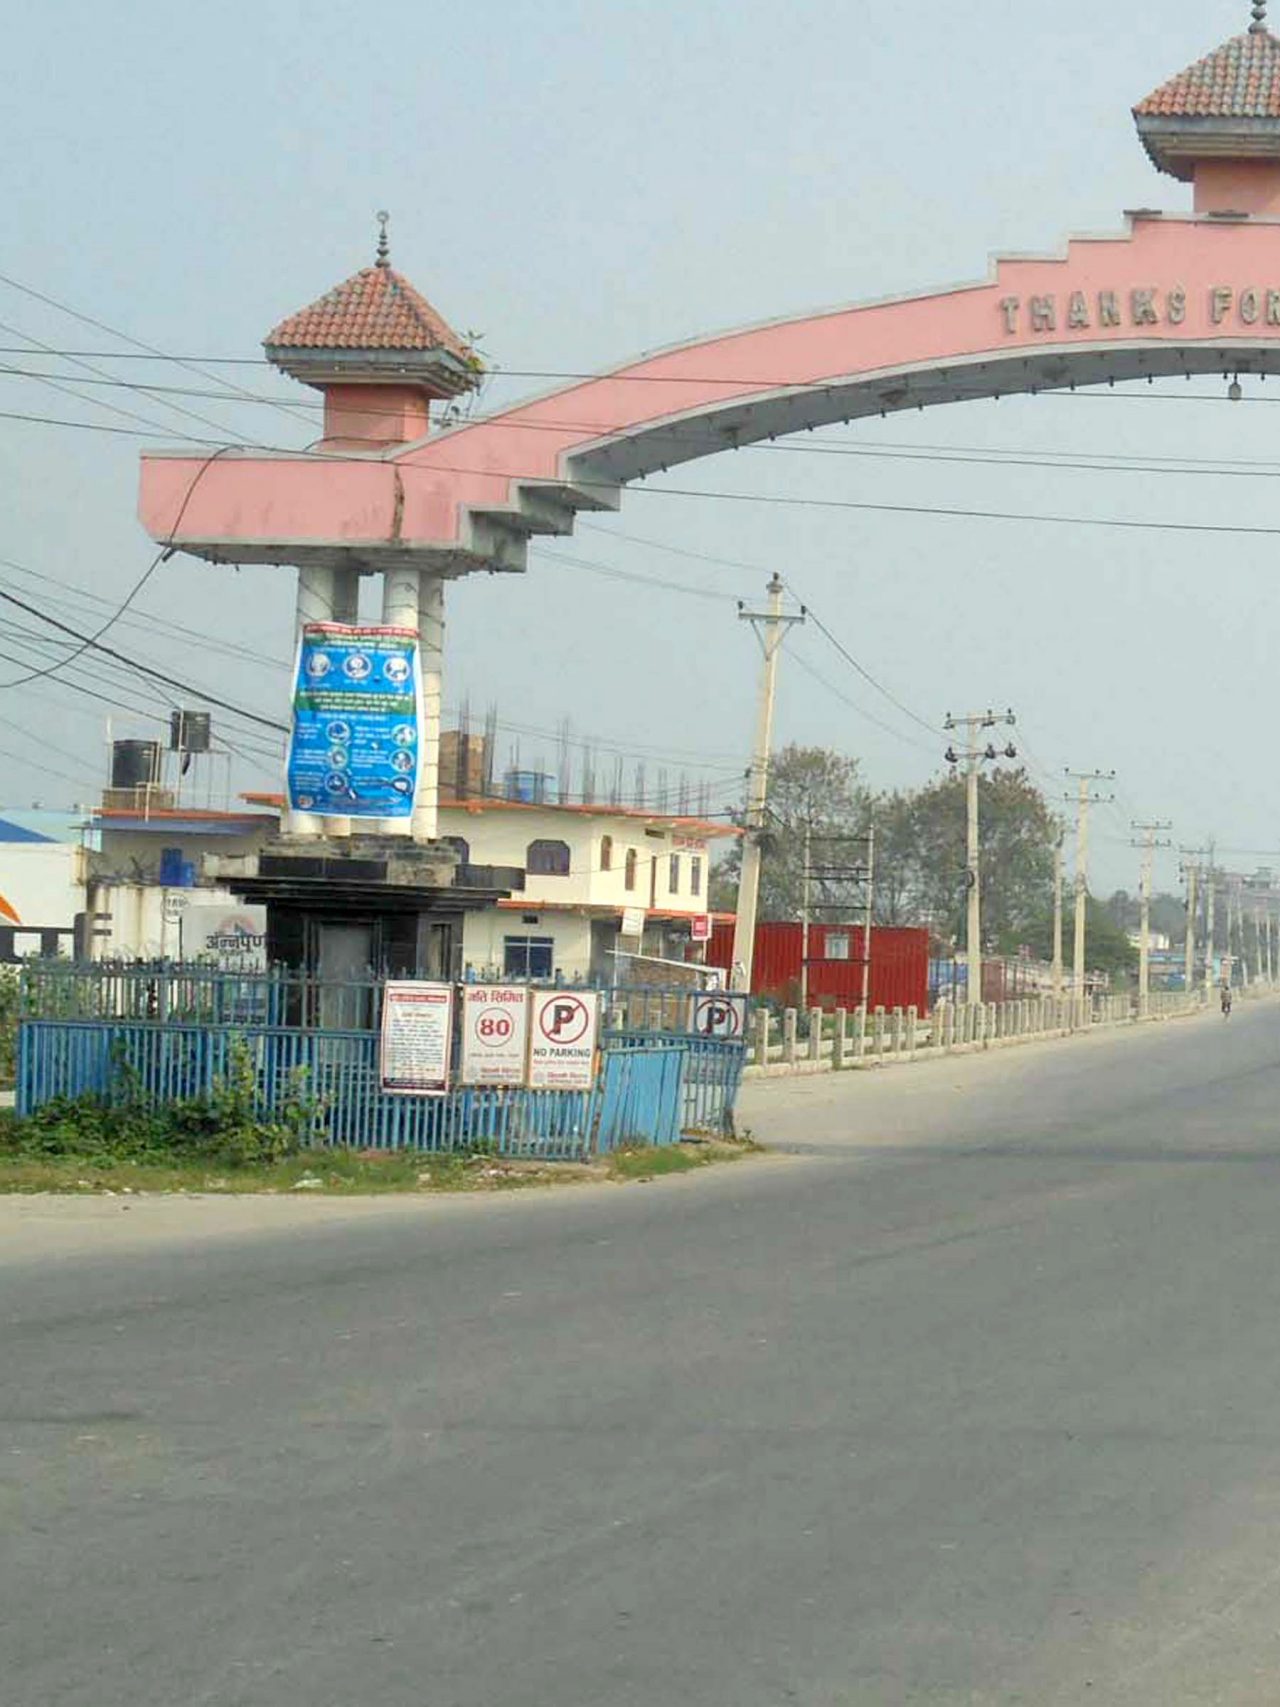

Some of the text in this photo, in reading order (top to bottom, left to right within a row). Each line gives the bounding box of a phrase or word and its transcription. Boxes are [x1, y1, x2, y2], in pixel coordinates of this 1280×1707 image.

[1001, 286, 1186, 333] THANKS
[480, 1018, 510, 1036] 80
[553, 1004, 574, 1035] P
[707, 1007, 726, 1035] P
[533, 1048, 591, 1058] NO PARKING
